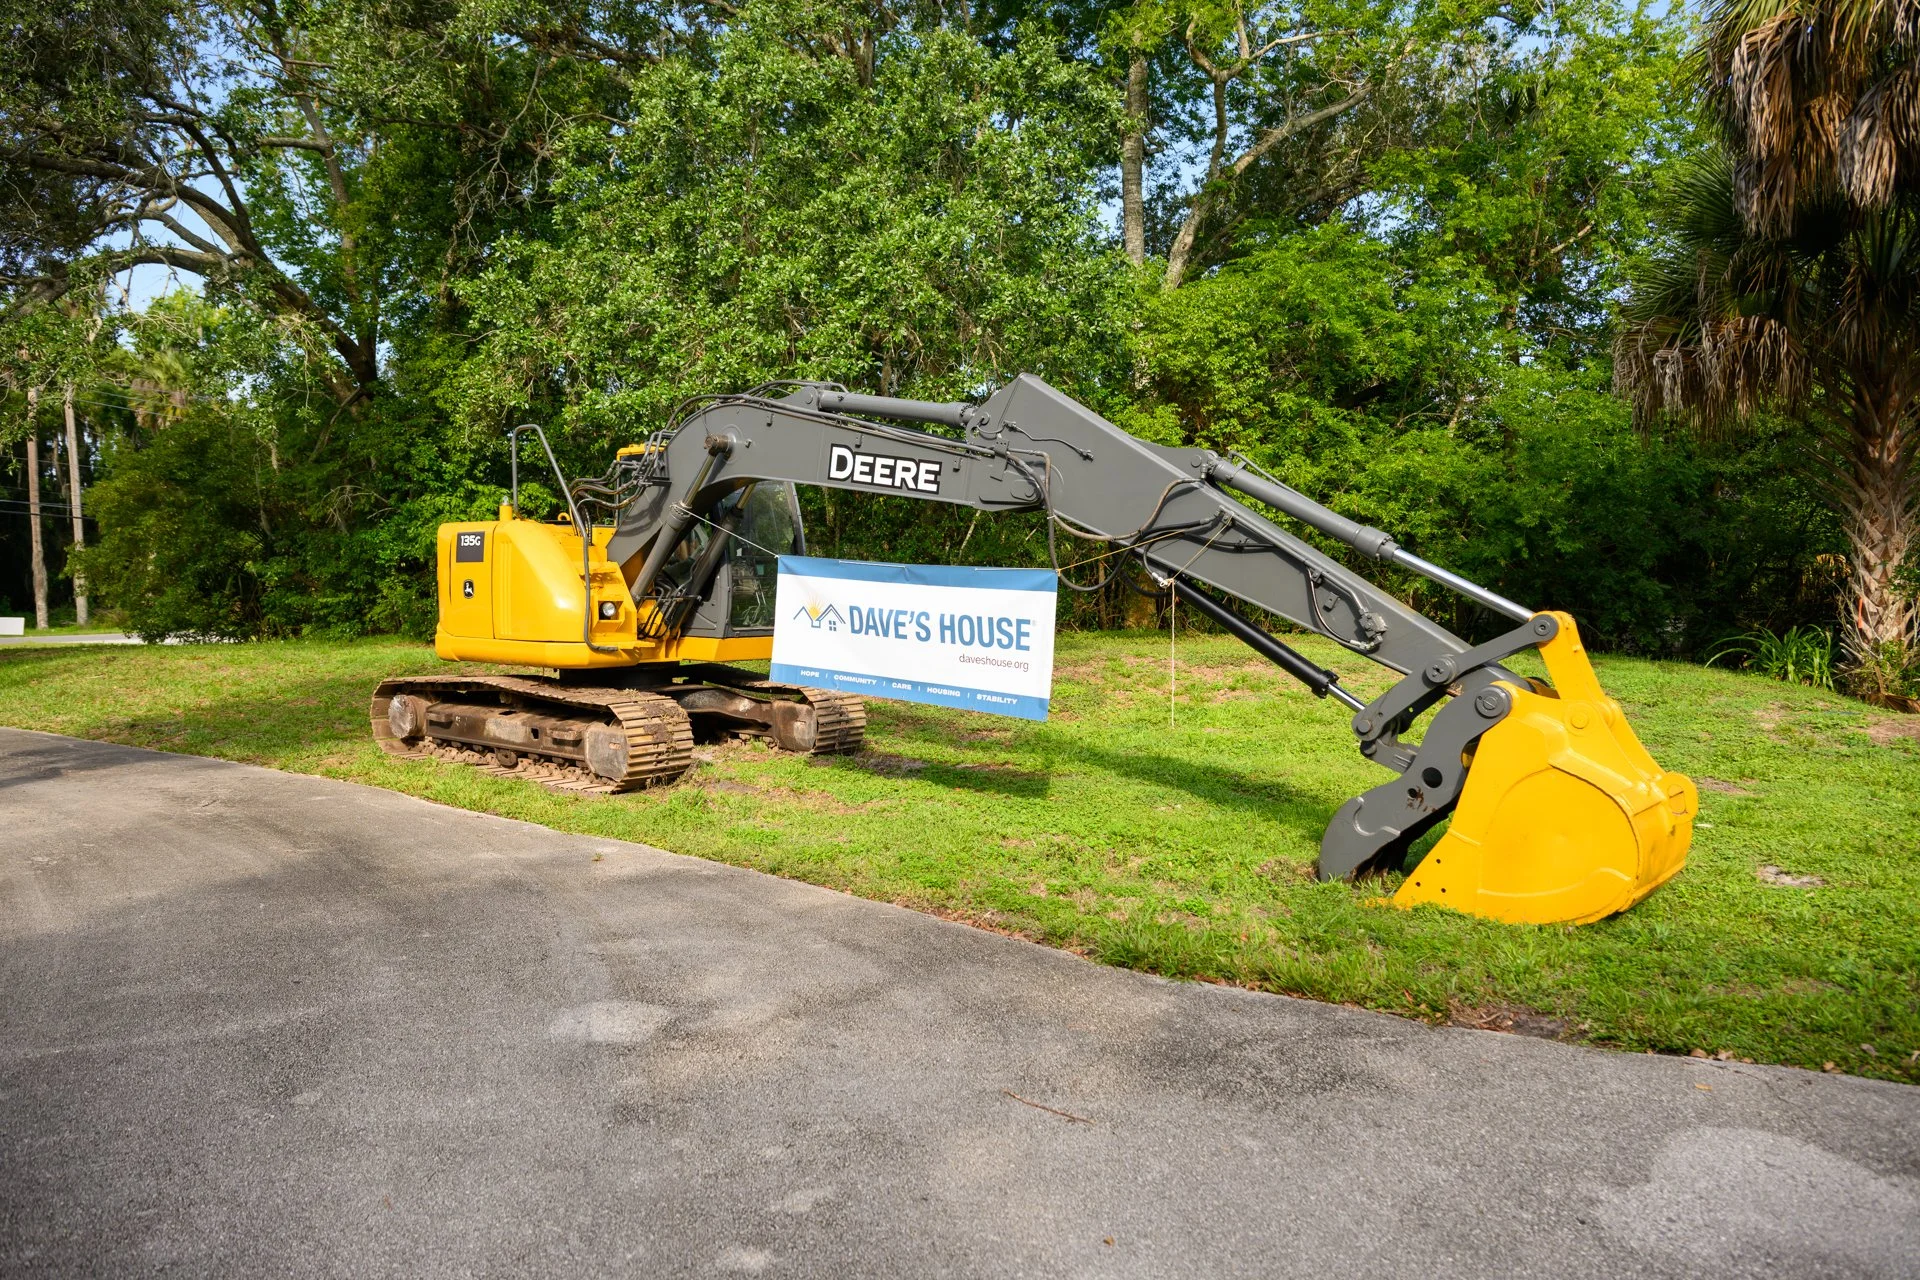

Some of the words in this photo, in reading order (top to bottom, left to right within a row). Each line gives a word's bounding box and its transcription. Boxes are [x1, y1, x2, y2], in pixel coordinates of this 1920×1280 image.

[829, 444, 941, 493] DEERE
[460, 535, 481, 546] 135G
[848, 605, 931, 642] DAVE'S
[939, 613, 1031, 651] HOUSE
[958, 653, 1029, 672] daveshouse.org
[800, 669, 820, 678] HOPE
[833, 674, 877, 686] COMMUNITY
[891, 682, 912, 690] CARE
[926, 687, 961, 697] HOUSING
[976, 693, 1018, 705] STABILITY
